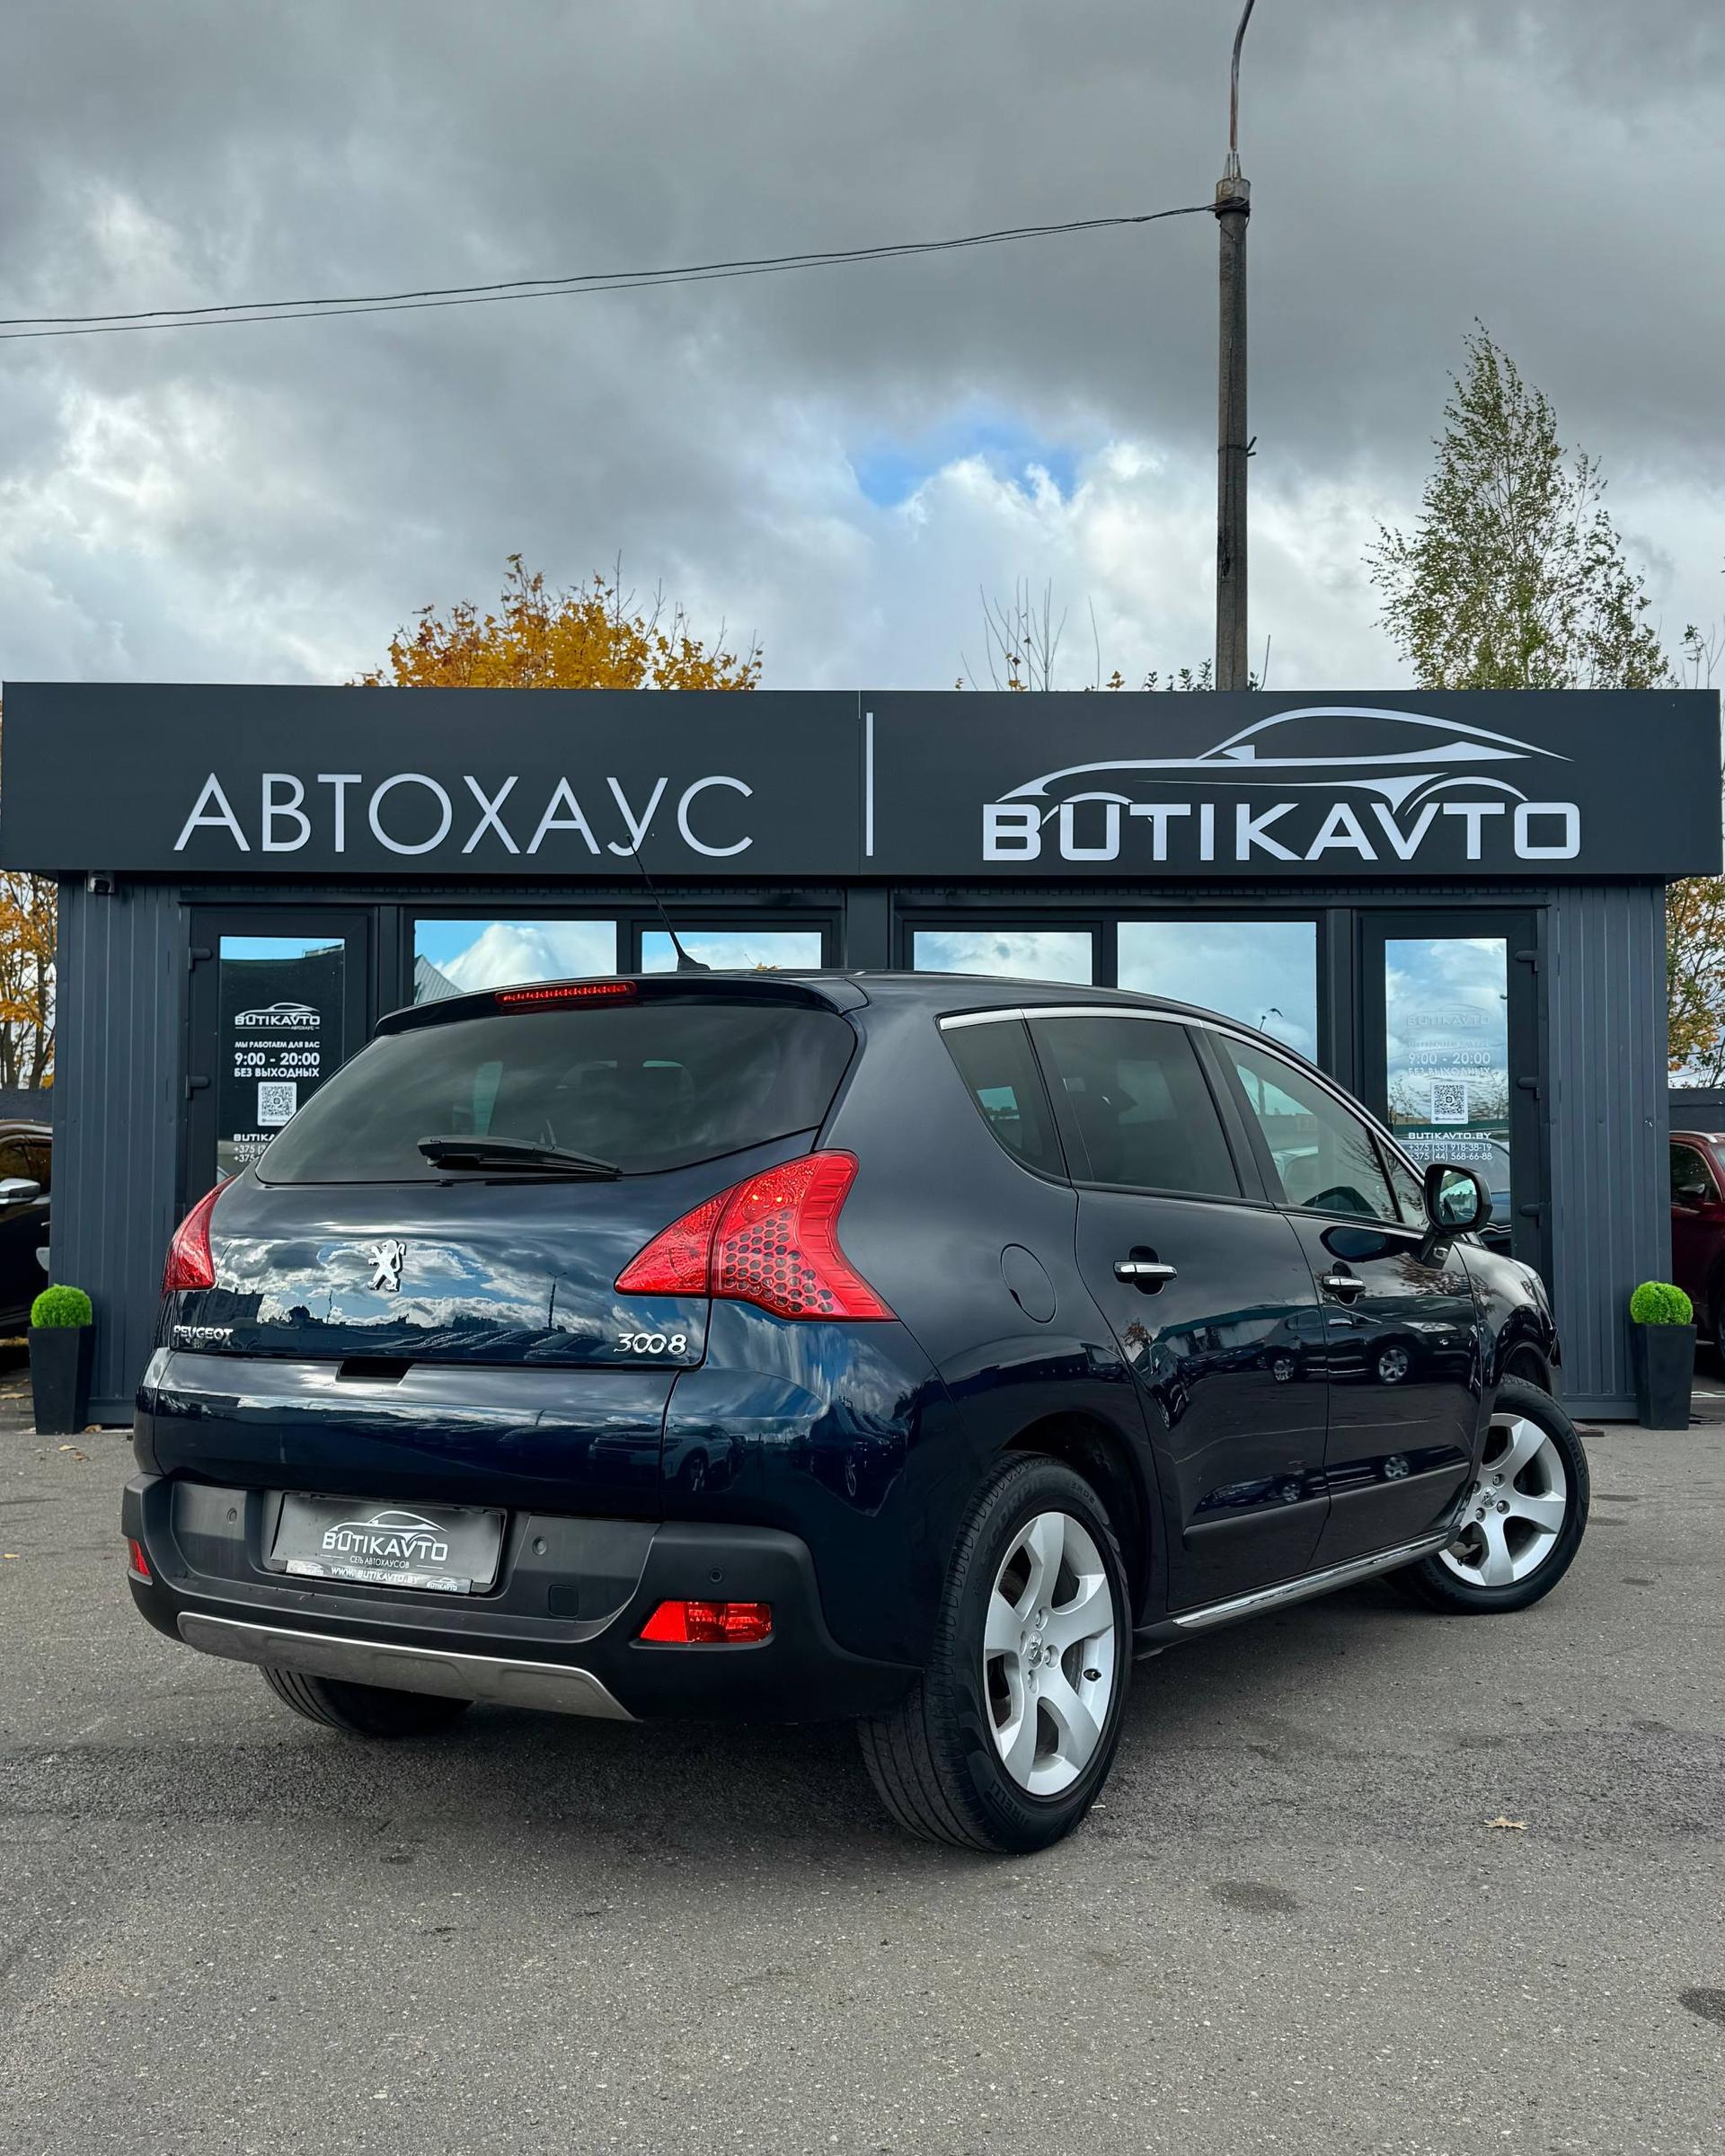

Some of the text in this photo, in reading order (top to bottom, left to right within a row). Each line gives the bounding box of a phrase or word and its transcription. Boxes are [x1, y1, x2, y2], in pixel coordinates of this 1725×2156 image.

[173, 773, 754, 858] АВТОХАУС
[982, 800, 1581, 862] BUTIKAVTO
[234, 1015, 321, 1025] BUTIKAVTO
[234, 1052, 266, 1065] 9:00
[279, 1052, 321, 1065] 20:00
[1408, 1052, 1438, 1065] 9:00
[1452, 1052, 1491, 1065] 20:00
[234, 1067, 320, 1078] БЕЗ ВЫХОДНЫХ
[1408, 1132, 1492, 1140] BUTIKAVTO.BY
[234, 1144, 255, 1153] +375
[1409, 1144, 1430, 1152] +375
[1432, 1144, 1448, 1153] (33)
[1432, 1153, 1448, 1162] (44)
[173, 1325, 234, 1340] PEUGEOT
[613, 1332, 687, 1356] 3008
[322, 1531, 448, 1561] BUTIKAVTO
[364, 1557, 410, 1569] АВТОХАУСОВ
